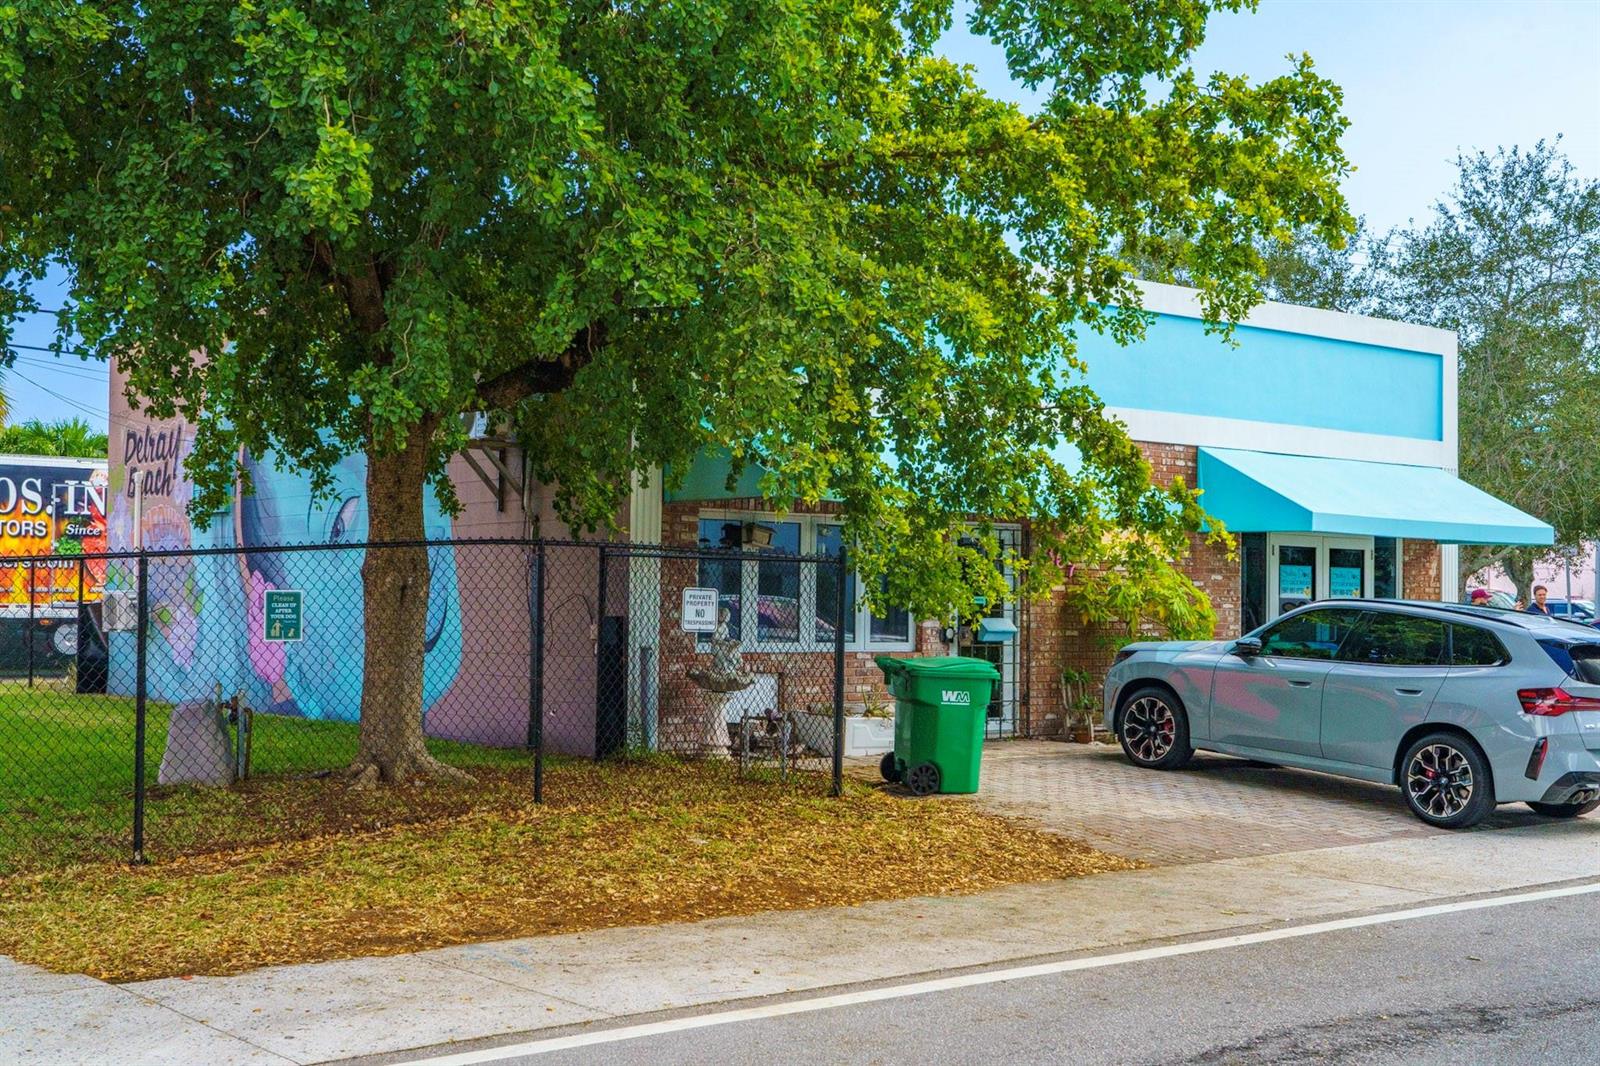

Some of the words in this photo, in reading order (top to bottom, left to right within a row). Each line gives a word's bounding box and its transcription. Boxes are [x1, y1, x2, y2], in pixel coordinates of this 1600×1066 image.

[125, 424, 181, 479] Delray
[127, 461, 174, 498] Bach
[66, 524, 101, 536] Since
[273, 594, 295, 602] Please
[695, 608, 706, 618] NO
[941, 690, 971, 702] WM
